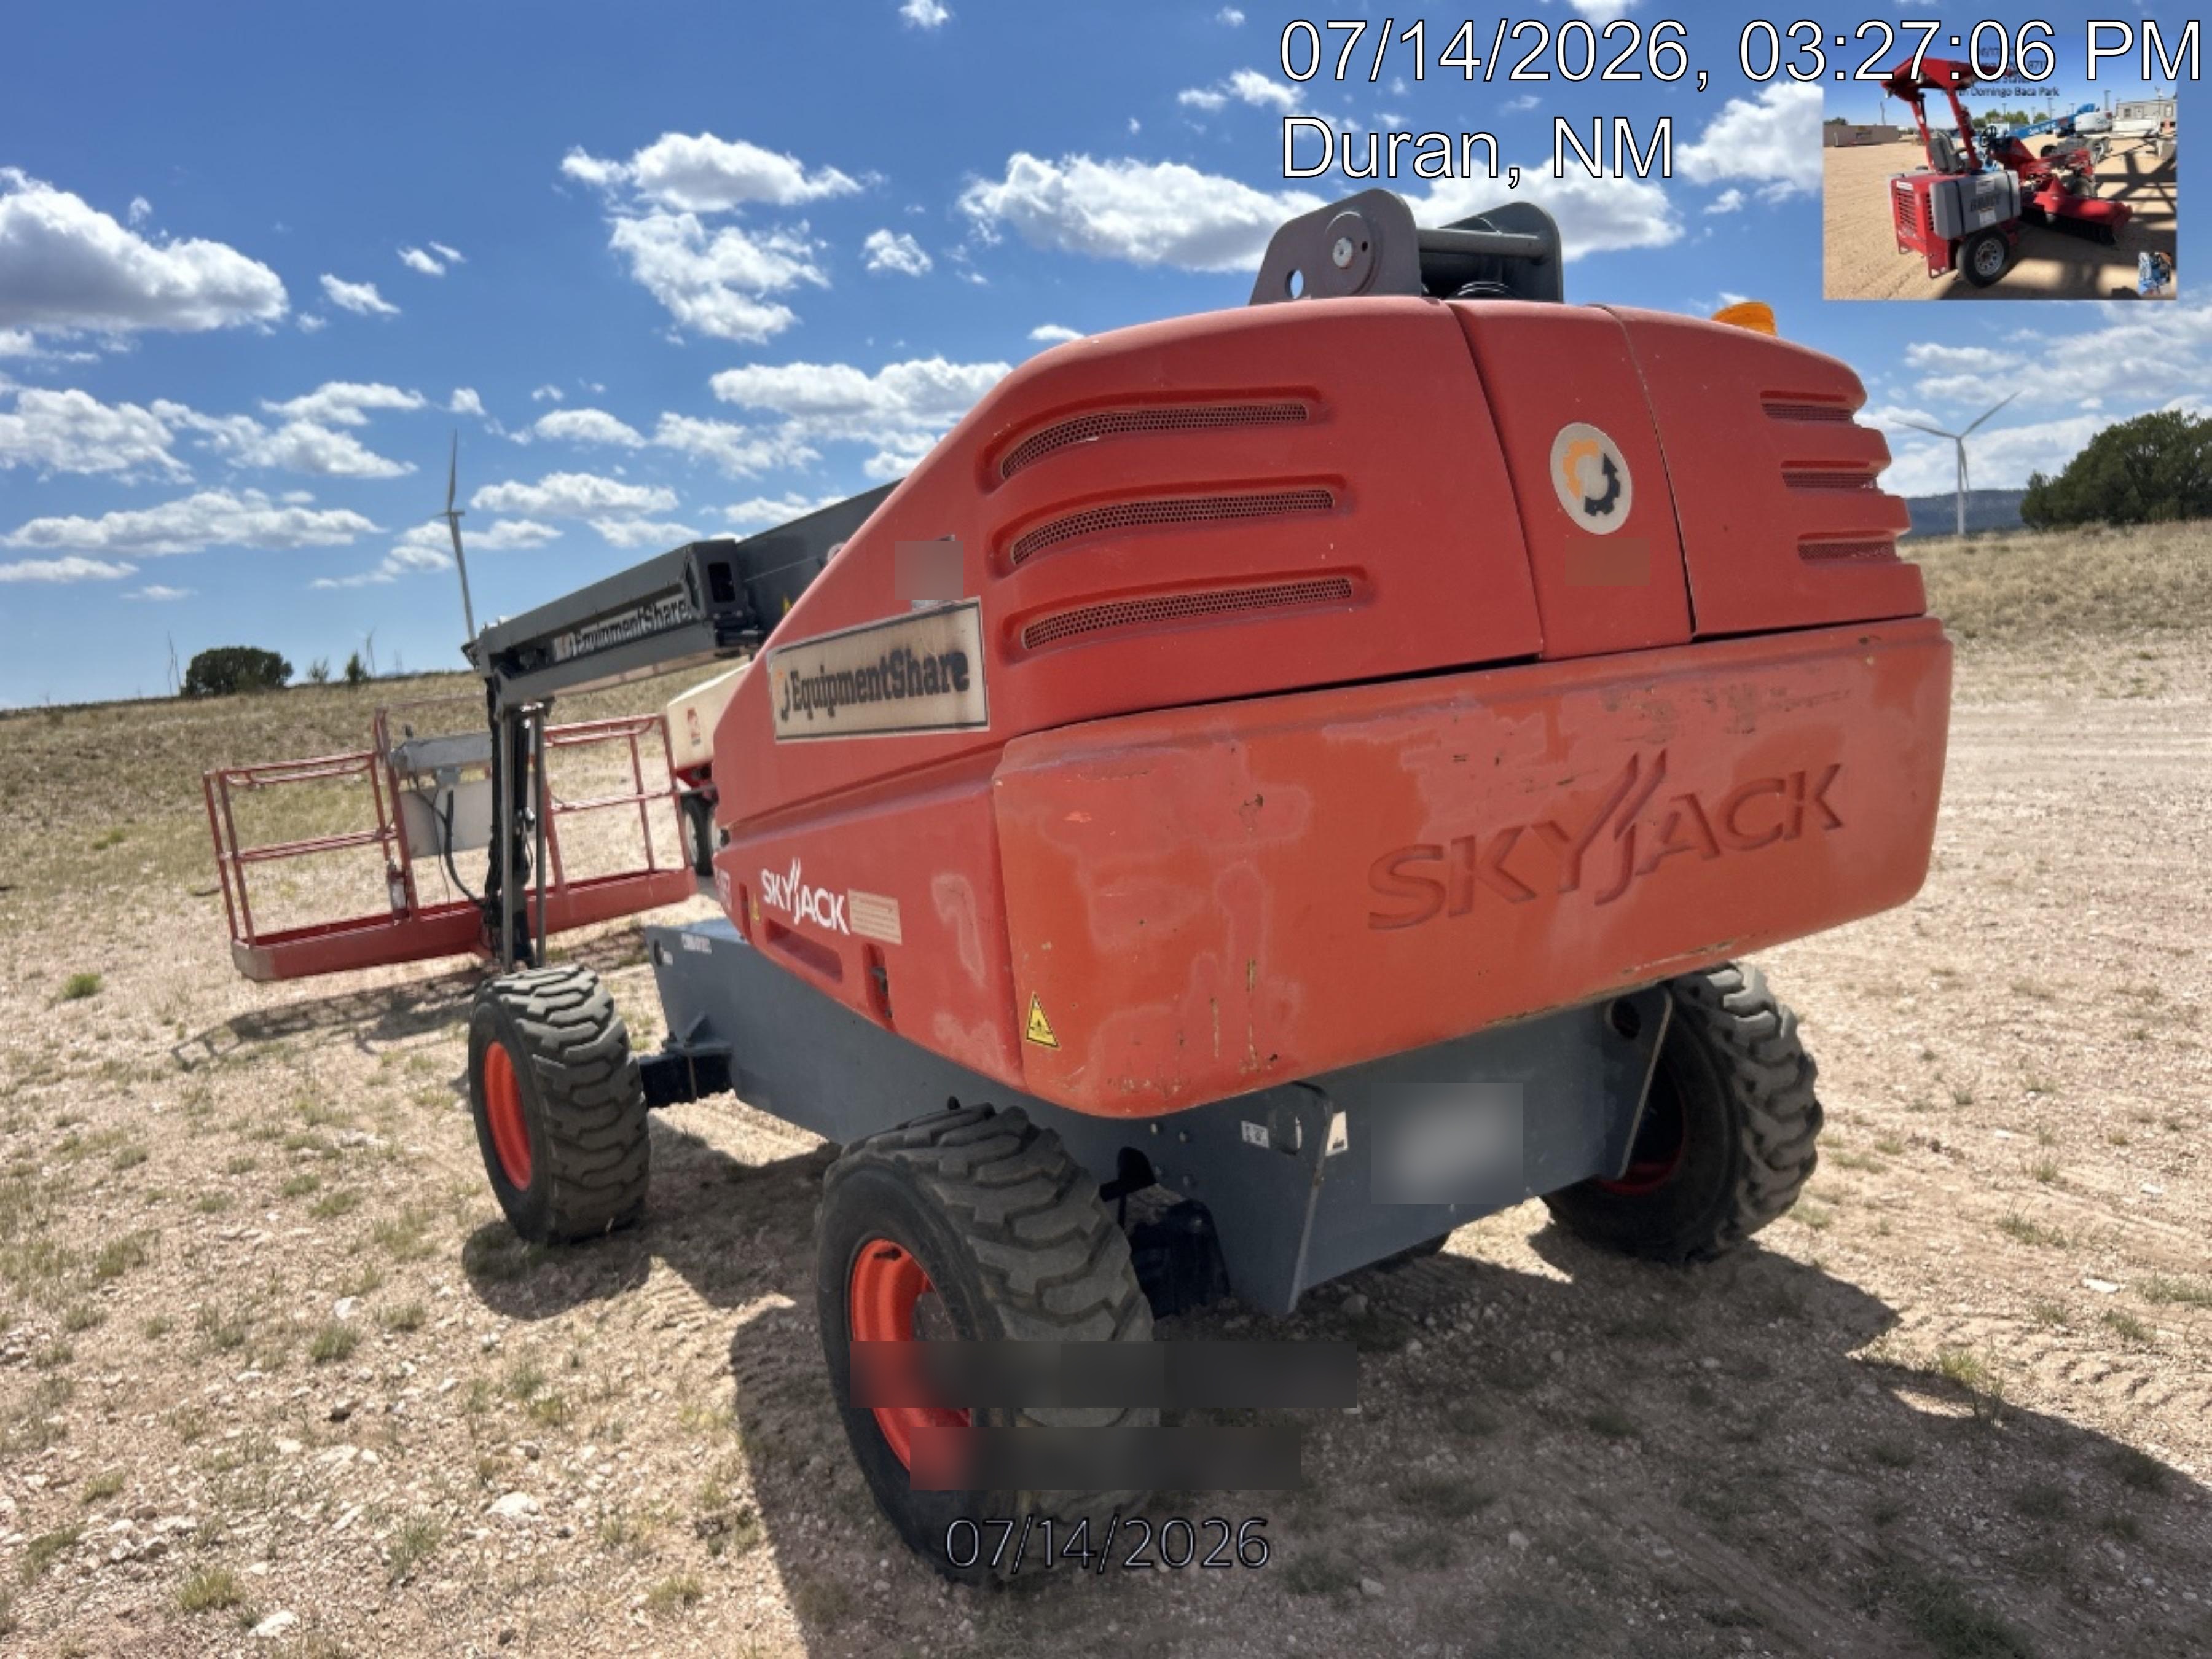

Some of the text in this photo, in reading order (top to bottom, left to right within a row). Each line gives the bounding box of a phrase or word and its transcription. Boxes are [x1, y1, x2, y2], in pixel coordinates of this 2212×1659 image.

[790, 644, 970, 720] EquipmentShare
[1368, 748, 1843, 930] SKYJACK
[761, 857, 850, 936] SKYJACK
